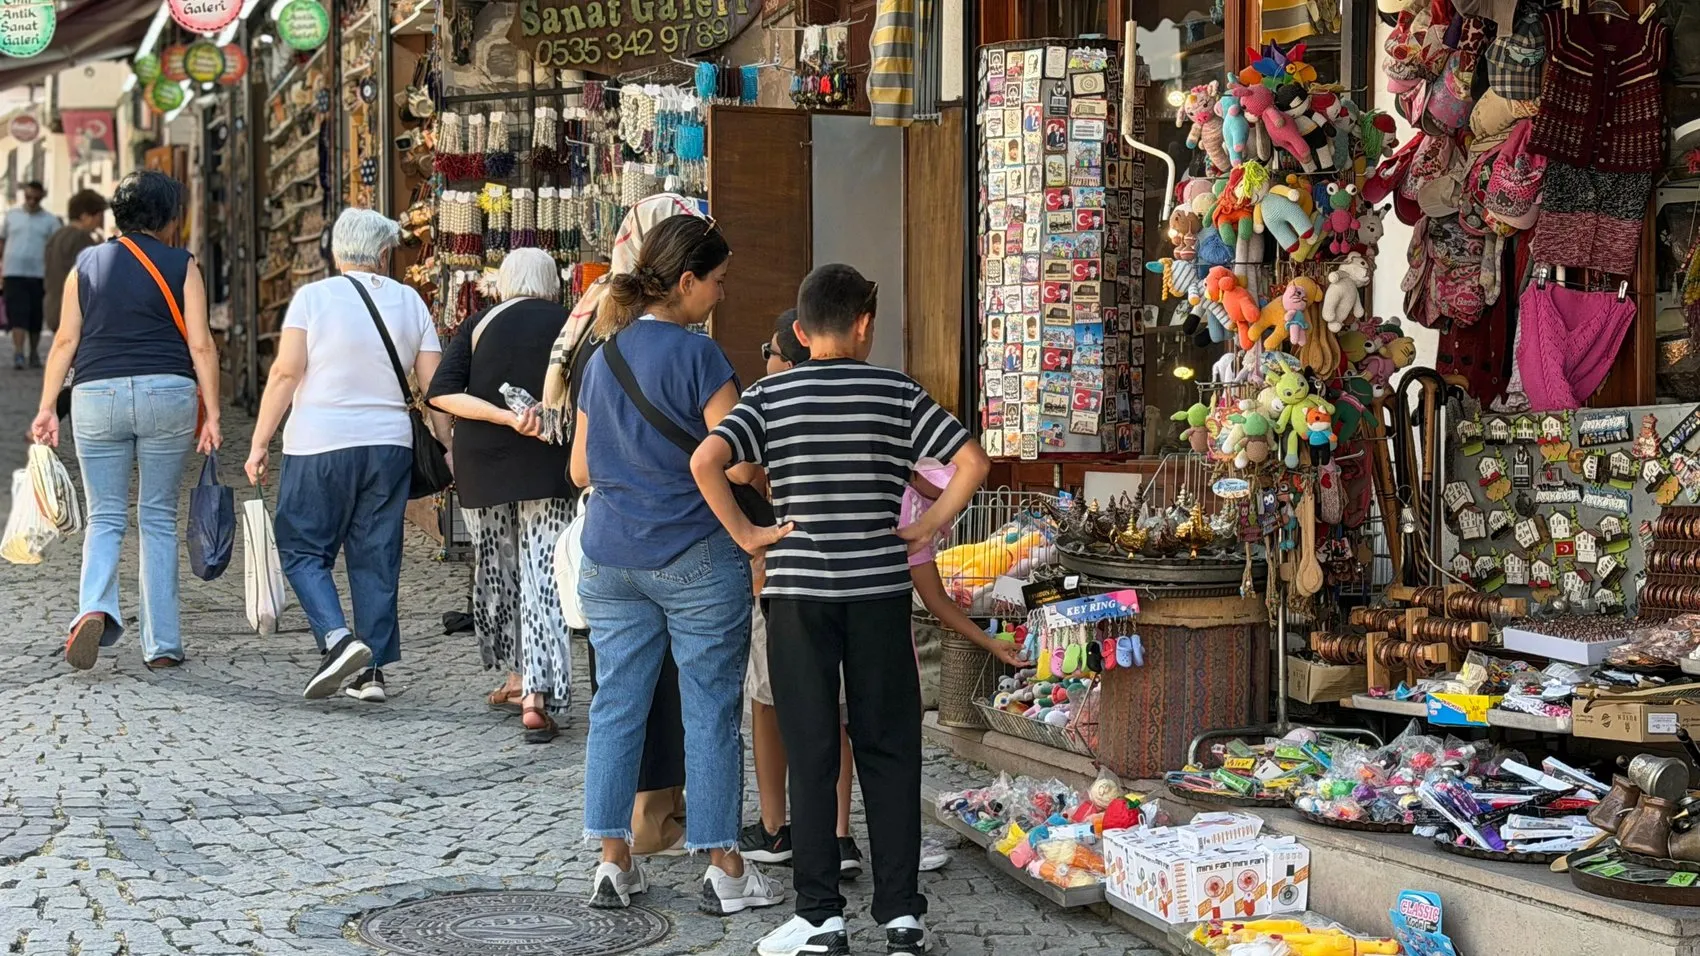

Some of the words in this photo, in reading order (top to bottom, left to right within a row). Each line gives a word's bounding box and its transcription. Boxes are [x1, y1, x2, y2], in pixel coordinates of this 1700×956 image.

[2, 8, 37, 19] Antik
[183, 1, 227, 15] Galeri
[521, 0, 621, 36] Sanat
[1, 21, 38, 32] Sanat
[3, 33, 40, 46] Galeri
[535, 37, 602, 66] 0535
[606, 28, 657, 59] 342
[1580, 416, 1626, 430] ANKARA
[1536, 489, 1583, 503] ANKARA
[1582, 494, 1628, 511] ANKARA
[1066, 604, 1088, 616] KEY
[1089, 599, 1116, 612] RING
[1401, 899, 1440, 923] CLASSIC
